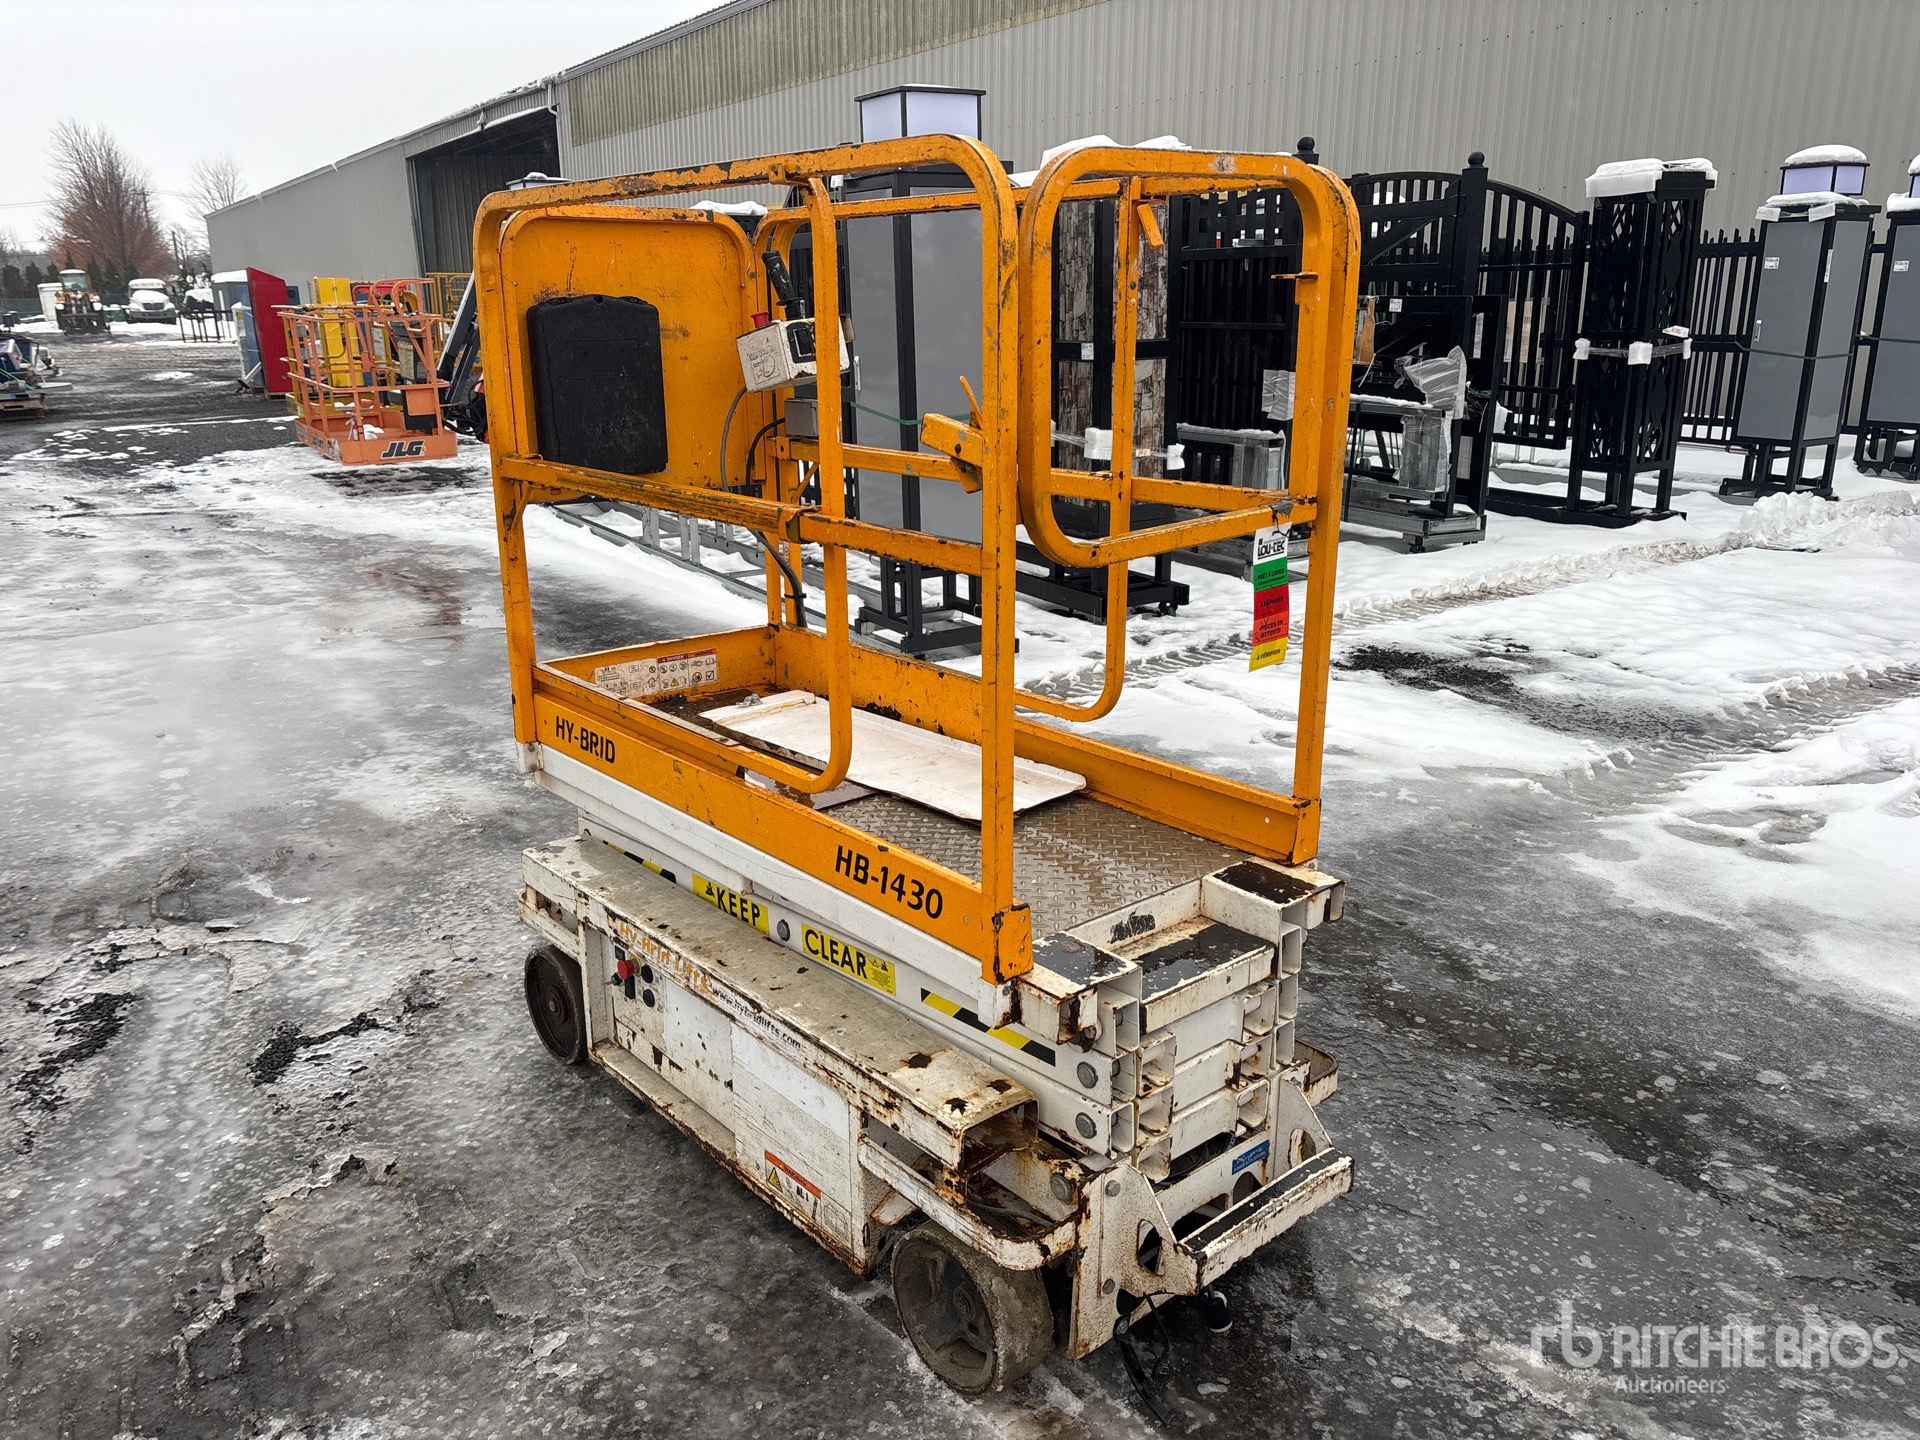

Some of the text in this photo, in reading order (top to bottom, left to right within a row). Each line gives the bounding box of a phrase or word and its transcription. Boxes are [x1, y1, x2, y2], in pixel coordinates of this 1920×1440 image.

[381, 440, 425, 459] JLG
[1257, 540, 1286, 557] LOU-TEC
[555, 715, 616, 764] HY-BRID
[835, 845, 943, 919] HB-1430
[716, 885, 761, 927] KEEP
[804, 929, 868, 979] CLEAR
